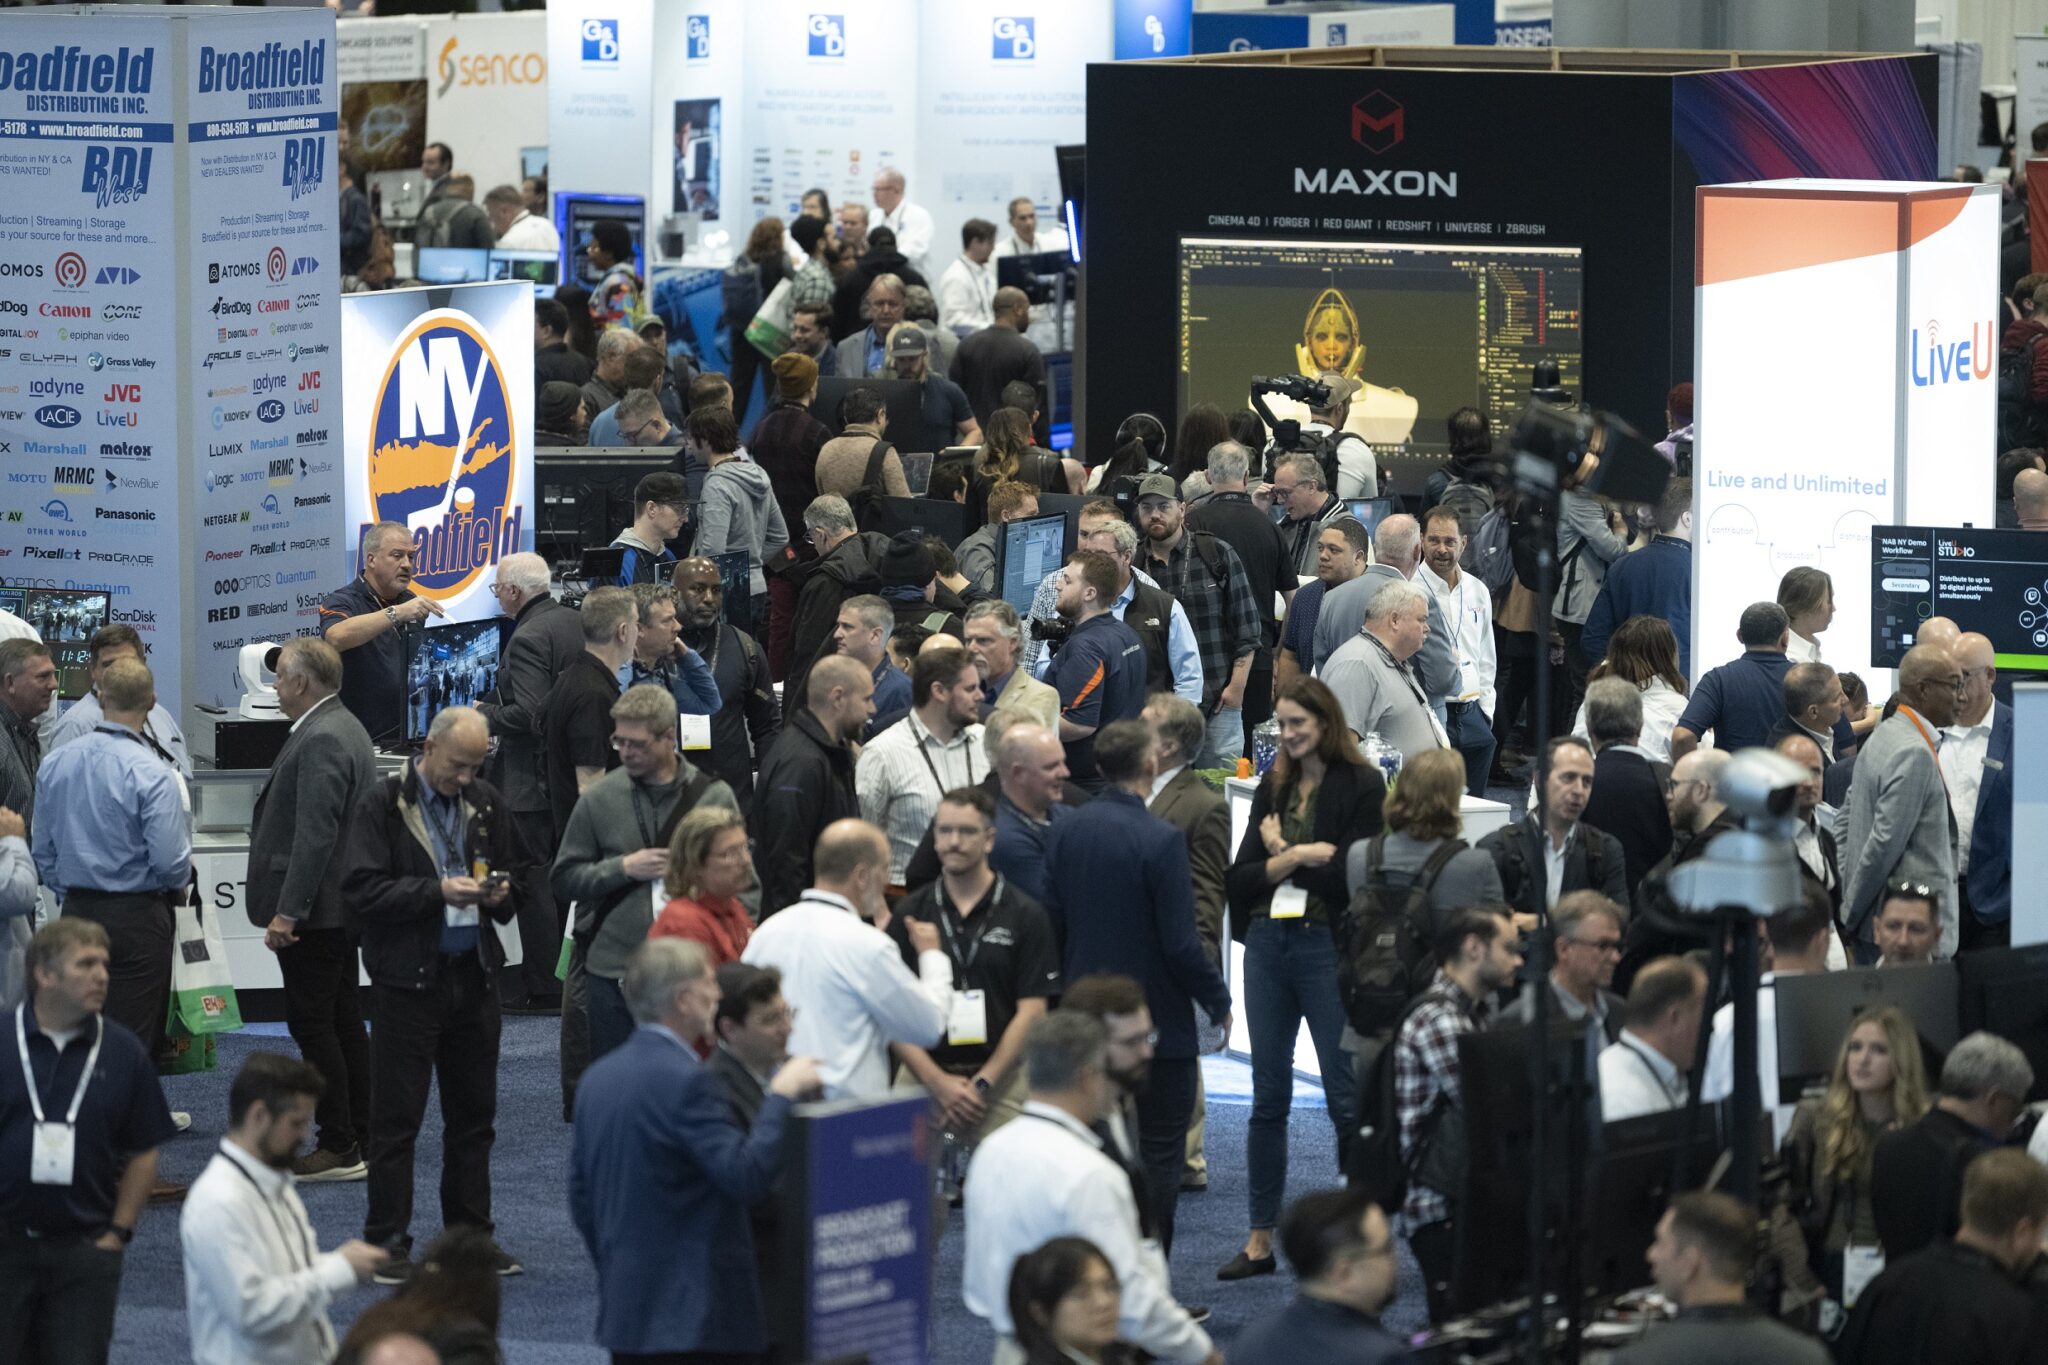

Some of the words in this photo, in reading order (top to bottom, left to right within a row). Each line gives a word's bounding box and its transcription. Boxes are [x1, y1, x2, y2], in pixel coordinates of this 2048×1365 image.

[199, 39, 325, 93] Broadfield
[27, 95, 118, 113] DISTRIBUTING
[123, 97, 148, 114] INC.
[248, 90, 304, 110] DISTRIBUTING
[306, 88, 322, 105] INC.
[39, 124, 143, 138] www.broadfield.com
[207, 122, 249, 137] 800-634-5178
[256, 118, 319, 134] www.broadfield.com
[38, 155, 50, 163] NY
[60, 156, 72, 164] CA
[283, 136, 325, 187] BDI
[13, 166, 51, 176] WANTED!
[82, 146, 152, 194] BDI
[201, 169, 213, 177] NEW
[215, 166, 239, 177] DEALERS
[291, 165, 319, 201] West
[1294, 167, 1458, 197] MAXON
[97, 175, 143, 209] West
[36, 215, 82, 229] Streaming
[90, 217, 125, 230] Storage
[220, 215, 250, 227] Production
[255, 212, 283, 223] Streaming
[288, 210, 309, 221] Storage
[1208, 214, 1245, 226] CINEMA
[1247, 216, 1260, 227] 4D
[1273, 217, 1310, 228] FORGER
[1323, 218, 1340, 229] RED
[1342, 218, 1372, 230] GIANT
[1386, 219, 1431, 232] REDSHIFT
[1445, 222, 1492, 233] UNIVERSE
[1506, 223, 1545, 235] ZBRUSH
[8, 231, 27, 241] your
[30, 232, 60, 240] source
[63, 230, 75, 241] for
[78, 232, 102, 242] these
[105, 233, 122, 243] and
[202, 231, 230, 242] Broadfield
[238, 230, 250, 241] your
[252, 228, 270, 238] source
[281, 224, 295, 235] these
[297, 223, 307, 233] and
[222, 263, 260, 278] ATOMOS
[222, 301, 251, 315] BirdDog
[257, 299, 290, 313] Canon
[296, 294, 320, 308] CORE
[39, 303, 91, 318] Canon
[103, 304, 142, 319] CORE
[277, 323, 297, 334] epiphan
[299, 321, 313, 330] video
[70, 331, 103, 341] epiphan
[106, 331, 129, 341] video
[208, 350, 241, 360] FACILIS
[299, 346, 314, 355] Grass
[315, 344, 329, 354] Valley
[1912, 320, 1994, 387] LiveU
[107, 357, 130, 367] Grass
[132, 358, 156, 369] Valley
[298, 371, 320, 391] JVC
[104, 384, 141, 402] JVC
[294, 399, 319, 415] LiveU
[97, 411, 137, 427] LiveU
[296, 428, 328, 444] matrox
[24, 442, 86, 455] Marshall
[100, 442, 151, 456] matrox
[209, 443, 243, 457] LUMIX
[250, 436, 288, 451] Marshall
[269, 458, 294, 477] MRMC
[8, 473, 47, 484] MOTU
[54, 467, 95, 485] MRMC
[215, 474, 233, 487] Logic
[240, 471, 264, 482] MOTU
[1708, 470, 1745, 488] Live
[1751, 473, 1787, 490] and
[1794, 474, 1886, 496] Unlimited
[121, 478, 158, 489] NewBlue
[294, 493, 331, 508] Panasonic
[8, 512, 22, 521] AV
[95, 507, 156, 520] Panasonic
[204, 514, 237, 527] NETGEAR
[240, 512, 250, 522] AV
[27, 528, 53, 536] OTHER
[58, 529, 87, 537] WORLD
[252, 523, 269, 532] OTHER
[272, 521, 290, 530] WORLD
[250, 541, 286, 556] Pixellot
[1938, 539, 1956, 547] LiveU
[23, 546, 82, 560] Pixellot
[205, 550, 243, 562] Pioneer
[1882, 547, 1913, 555] Workflow
[276, 570, 316, 584] Quantum
[65, 580, 130, 595] Quantum
[1947, 584, 1965, 592] digital
[112, 609, 156, 622] SanDisk
[208, 605, 240, 623] RED
[260, 601, 287, 616] Roland
